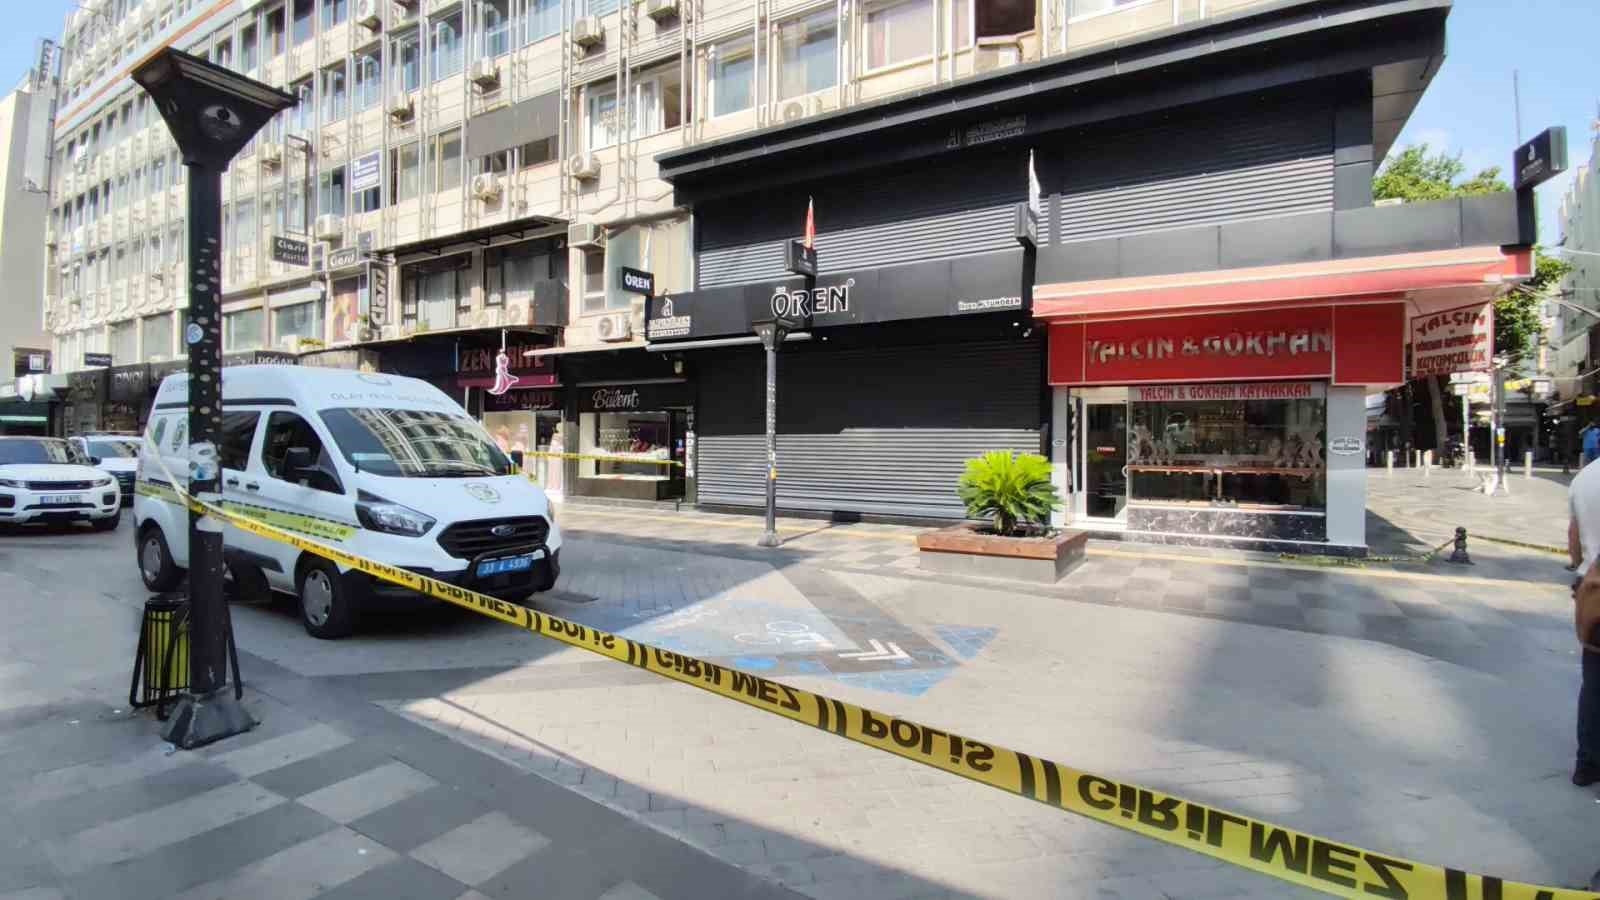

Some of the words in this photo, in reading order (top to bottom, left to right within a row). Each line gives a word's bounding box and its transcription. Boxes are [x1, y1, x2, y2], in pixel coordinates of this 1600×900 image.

[625, 272, 650, 289] ÖREN
[771, 286, 848, 317] ÖREN
[1416, 311, 1486, 336] YALÇIN
[593, 389, 640, 409] Bülent
[1139, 386, 1173, 401] YALÇIN
[1190, 384, 1233, 400] GÖKHAN
[1239, 382, 1312, 399] KAYNAKKAN
